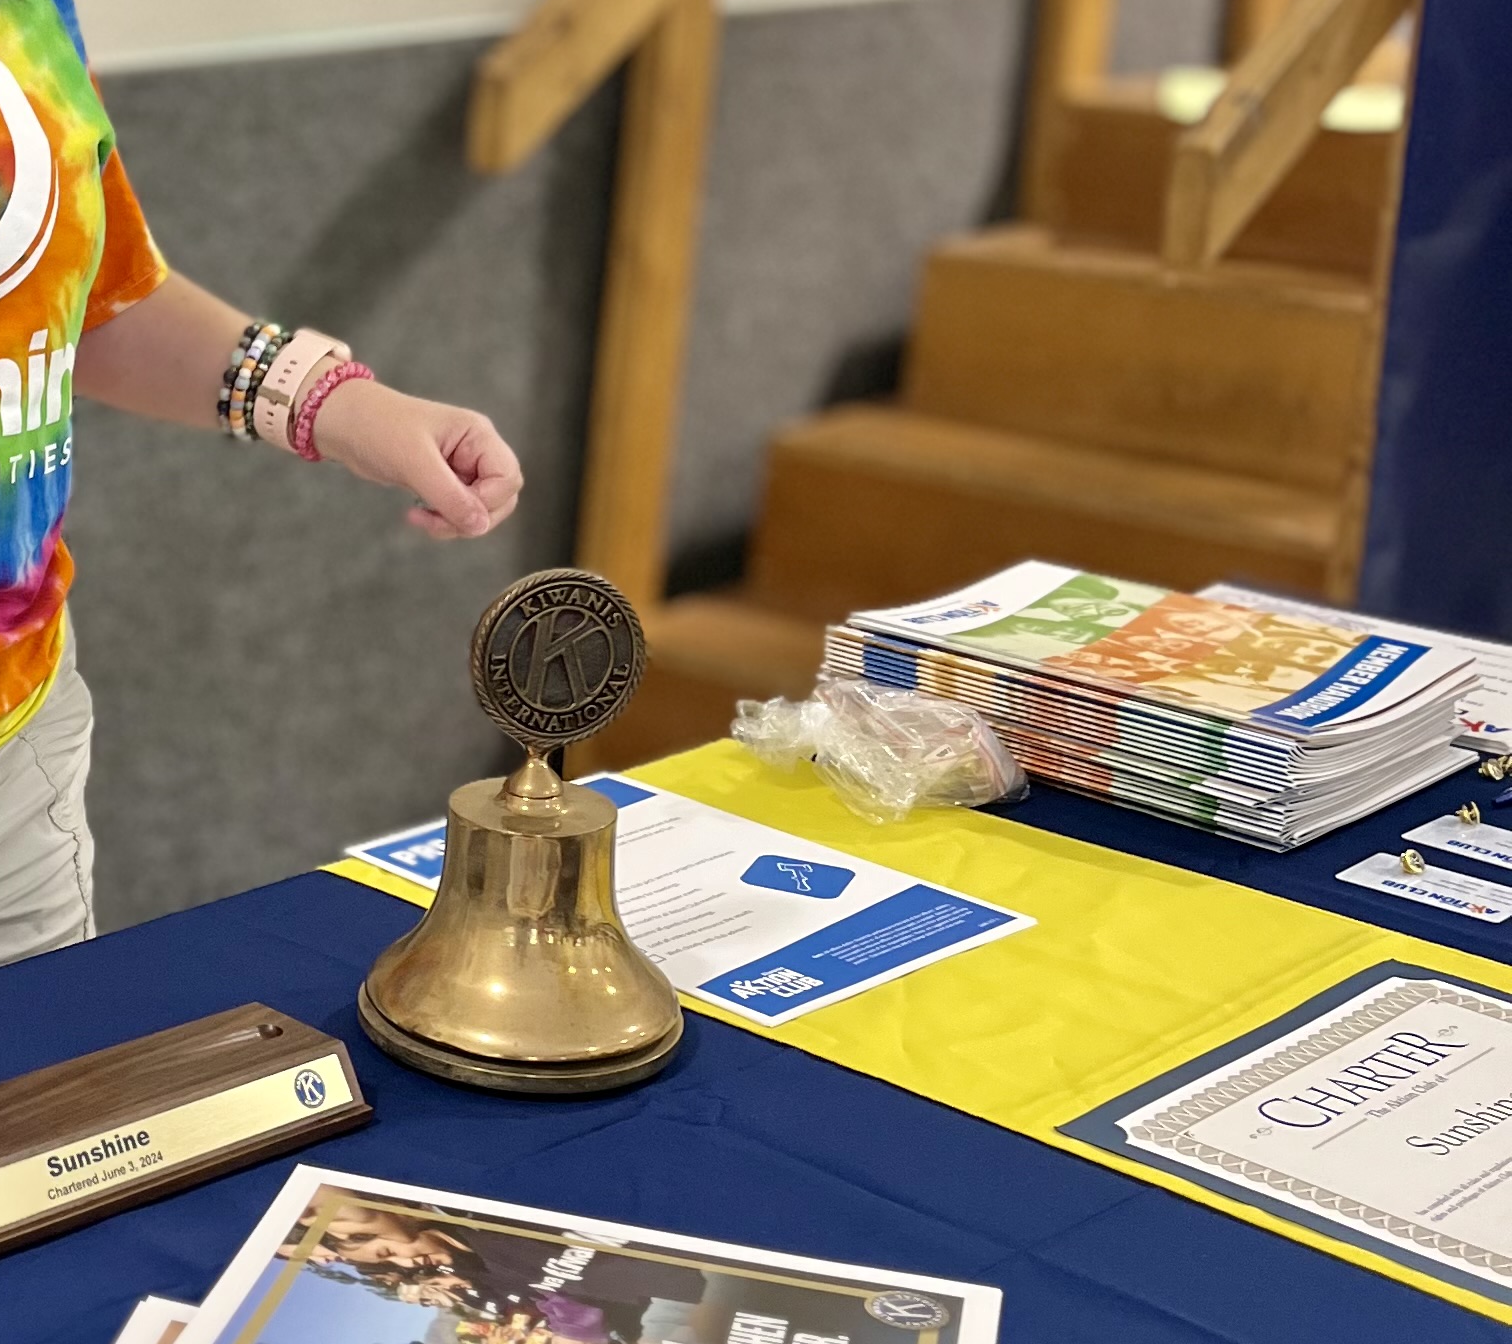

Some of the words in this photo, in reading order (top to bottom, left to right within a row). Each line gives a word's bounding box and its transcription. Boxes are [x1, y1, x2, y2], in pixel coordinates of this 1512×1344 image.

[520, 587, 623, 629] KIWANIS
[1339, 642, 1411, 686] MEMBER
[490, 653, 631, 732] INTERNATIONAL
[1445, 838, 1494, 858] CLUB
[1381, 878, 1429, 897] CLUB
[729, 968, 805, 999] AKTION
[769, 976, 825, 998] CLUB
[1257, 1031, 1471, 1129] CHARTER
[1405, 1091, 1512, 1156] Sunshin
[47, 1130, 151, 1178] Sunshine
[48, 1173, 101, 1200] Chartered
[101, 1166, 127, 1183] June
[127, 1161, 140, 1173] 3,
[139, 1150, 164, 1169] 2024
